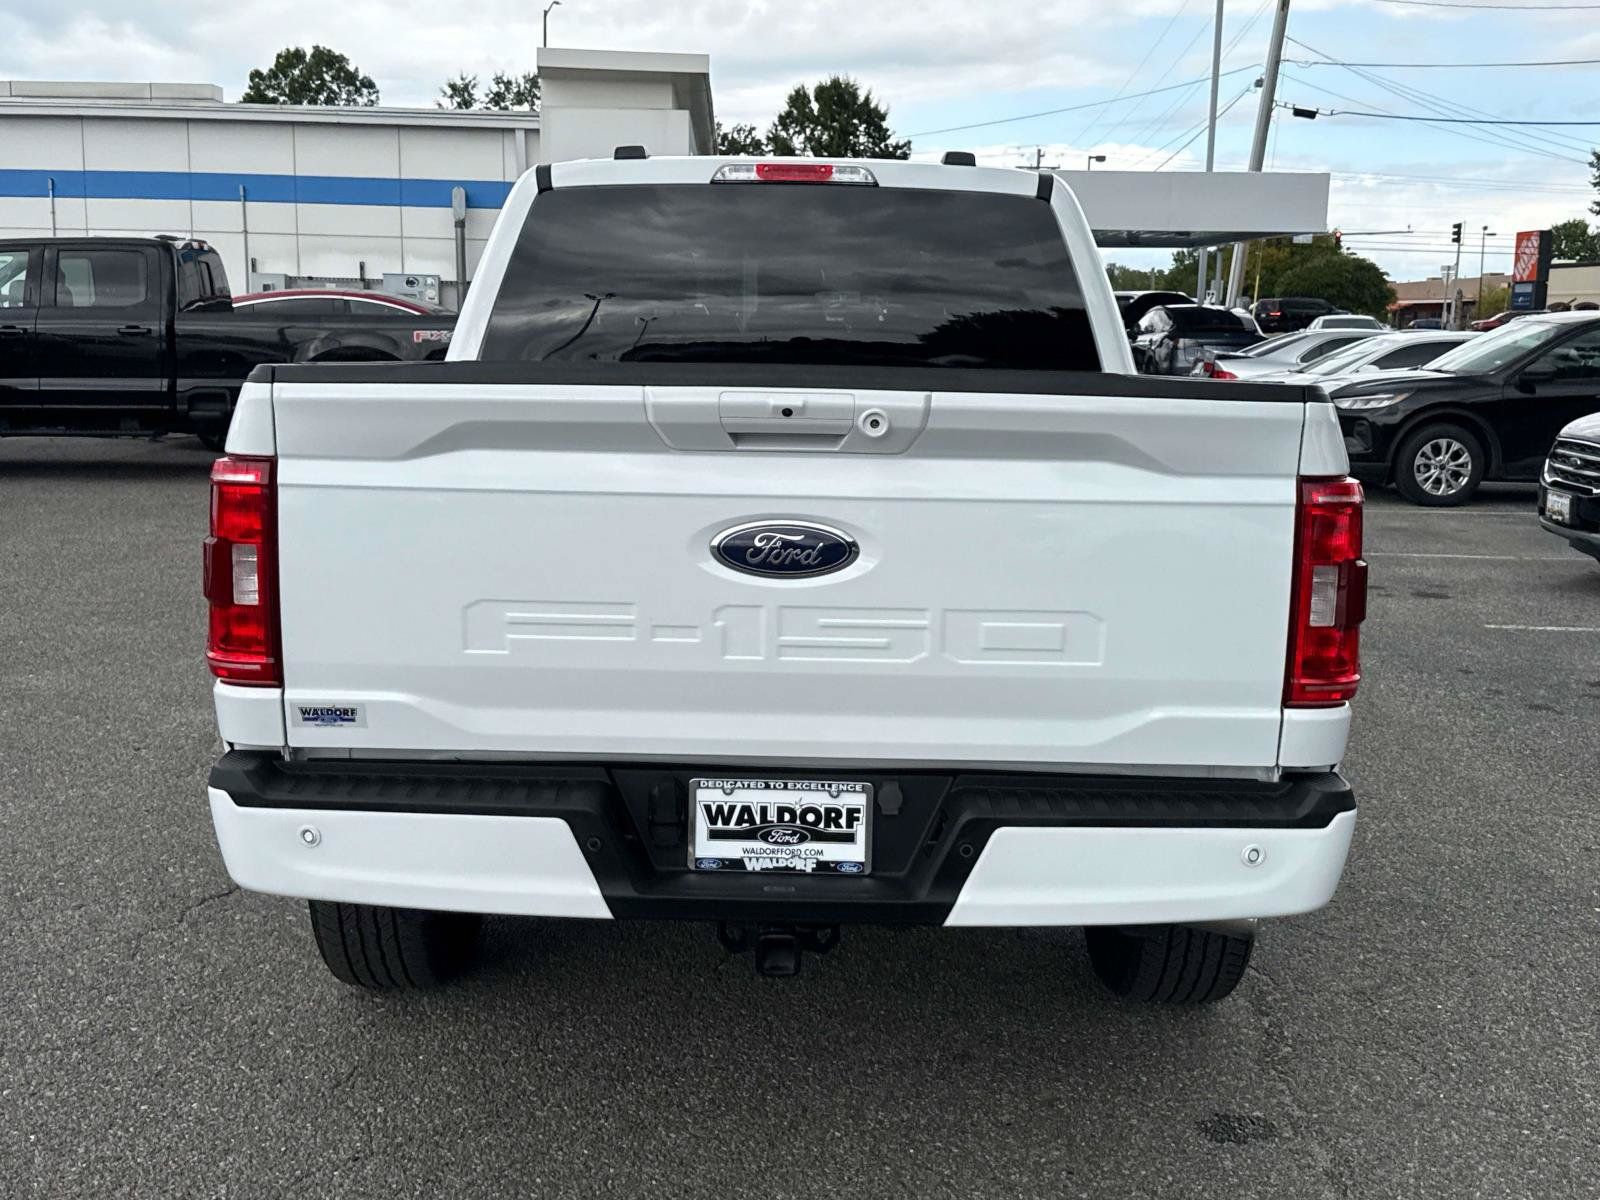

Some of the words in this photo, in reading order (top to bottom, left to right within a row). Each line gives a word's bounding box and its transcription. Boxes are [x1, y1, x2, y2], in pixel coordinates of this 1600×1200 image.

[745, 532, 824, 565] Ford
[462, 599, 1104, 667] F-150
[299, 707, 357, 717] WALDORF
[700, 780, 766, 788] DEDICATED
[787, 782, 863, 792] EXCELLENCE
[702, 803, 862, 829] WALDORF
[767, 828, 800, 845] Ford
[742, 847, 824, 857] WALDORFFORD.COM
[743, 857, 817, 873] WALDORF
